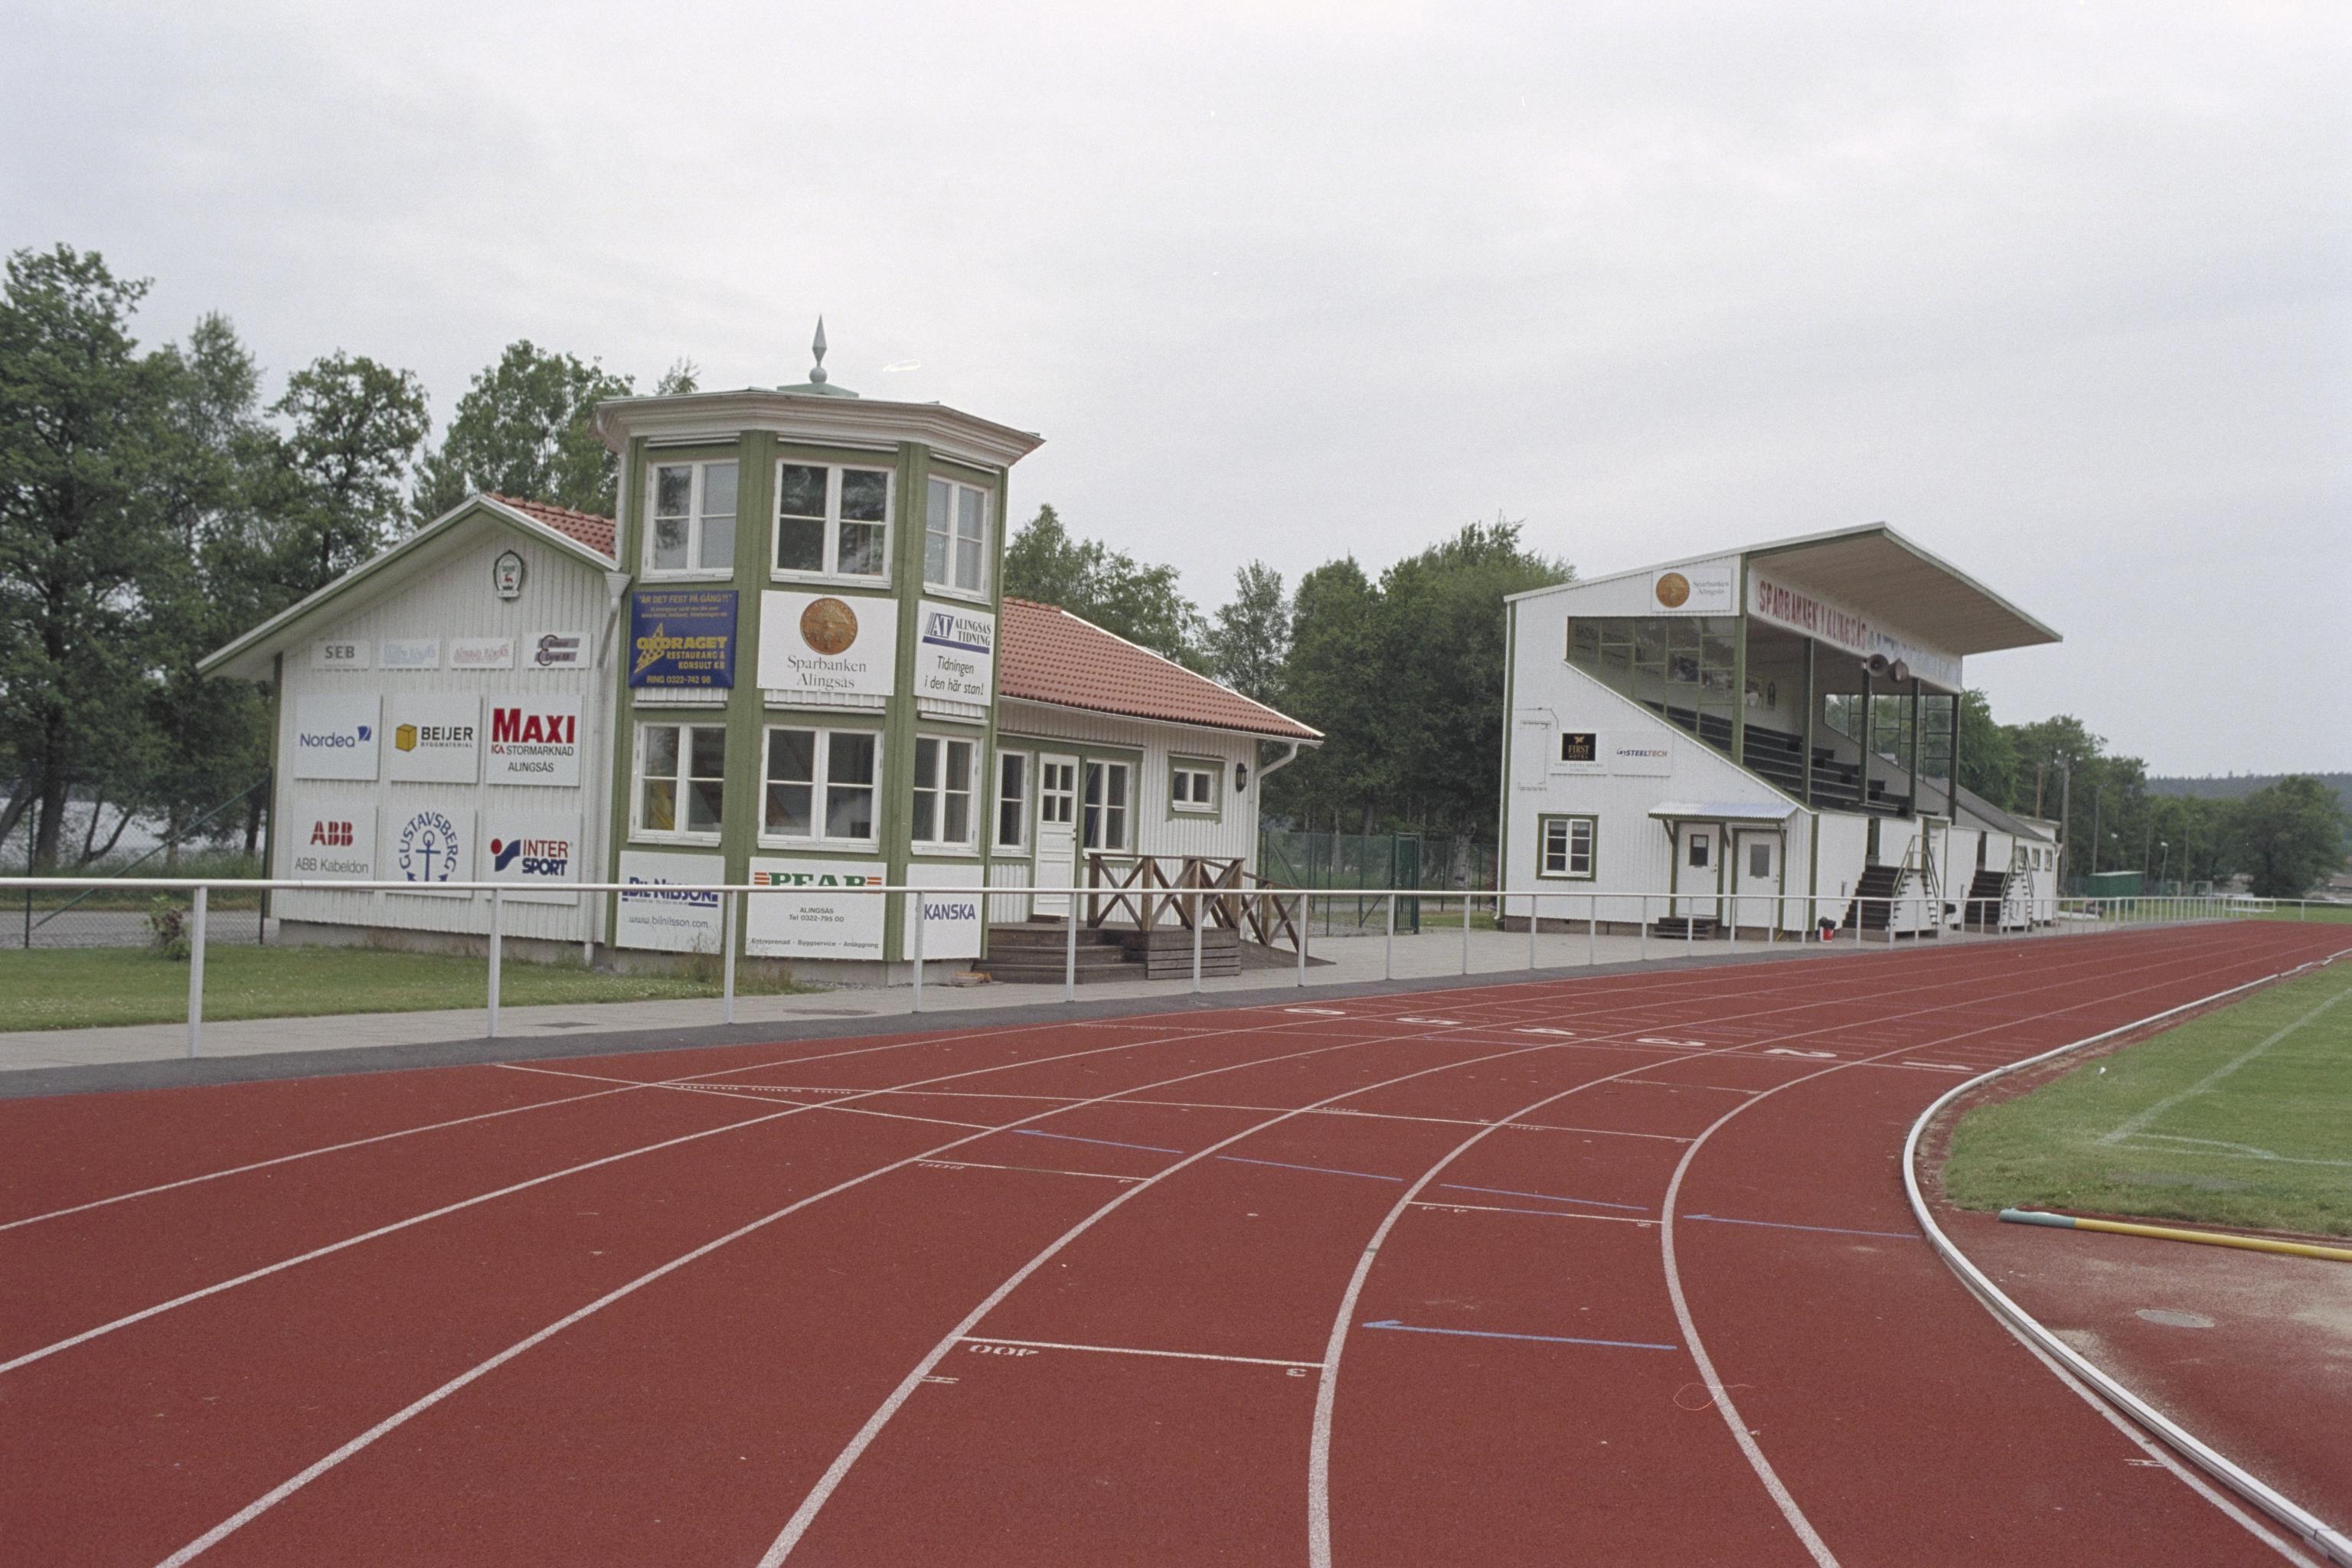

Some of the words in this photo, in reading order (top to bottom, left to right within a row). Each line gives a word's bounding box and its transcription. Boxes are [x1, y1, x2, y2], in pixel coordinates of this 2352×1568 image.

[1759, 580, 1818, 632] SPARBANKEN
[957, 630, 991, 646] TIDNING
[325, 645, 354, 659] SEB
[666, 651, 717, 660] RESTAURANG
[678, 661, 712, 670] KONSULT
[787, 655, 867, 673] Sparbanken
[937, 655, 975, 678] Tidningen
[647, 675, 665, 684] RING
[796, 672, 855, 691] Alingsås
[924, 675, 929, 688] i
[930, 675, 946, 691] den
[948, 678, 962, 693] här
[963, 682, 984, 695] stan!
[492, 708, 576, 744] MAXI
[300, 733, 355, 748] Nordea
[421, 727, 473, 741] BEIJER
[491, 744, 505, 755] ICA
[506, 745, 574, 756] STORMARKNAD
[1567, 744, 1590, 754] FIRST
[508, 760, 554, 773] ALINGSÅS
[310, 821, 354, 847] ABB
[398, 812, 459, 872] GUSTAVSBERG
[523, 839, 568, 858] INTER
[295, 857, 318, 871] ABB
[320, 858, 369, 874] Kabeldon
[522, 858, 567, 876] SPORT
[916, 903, 976, 920] KANSKA
[629, 916, 709, 929] www.bilnilsson.com
[798, 939, 837, 948] Byggservice
[1395, 1017, 1464, 1025] 5
[1510, 1027, 1576, 1036] 4
[1636, 1037, 1707, 1047] 3
[1762, 1048, 1838, 1058] 2
[969, 1344, 1040, 1357] 400
[1286, 1367, 1308, 1378] 3
